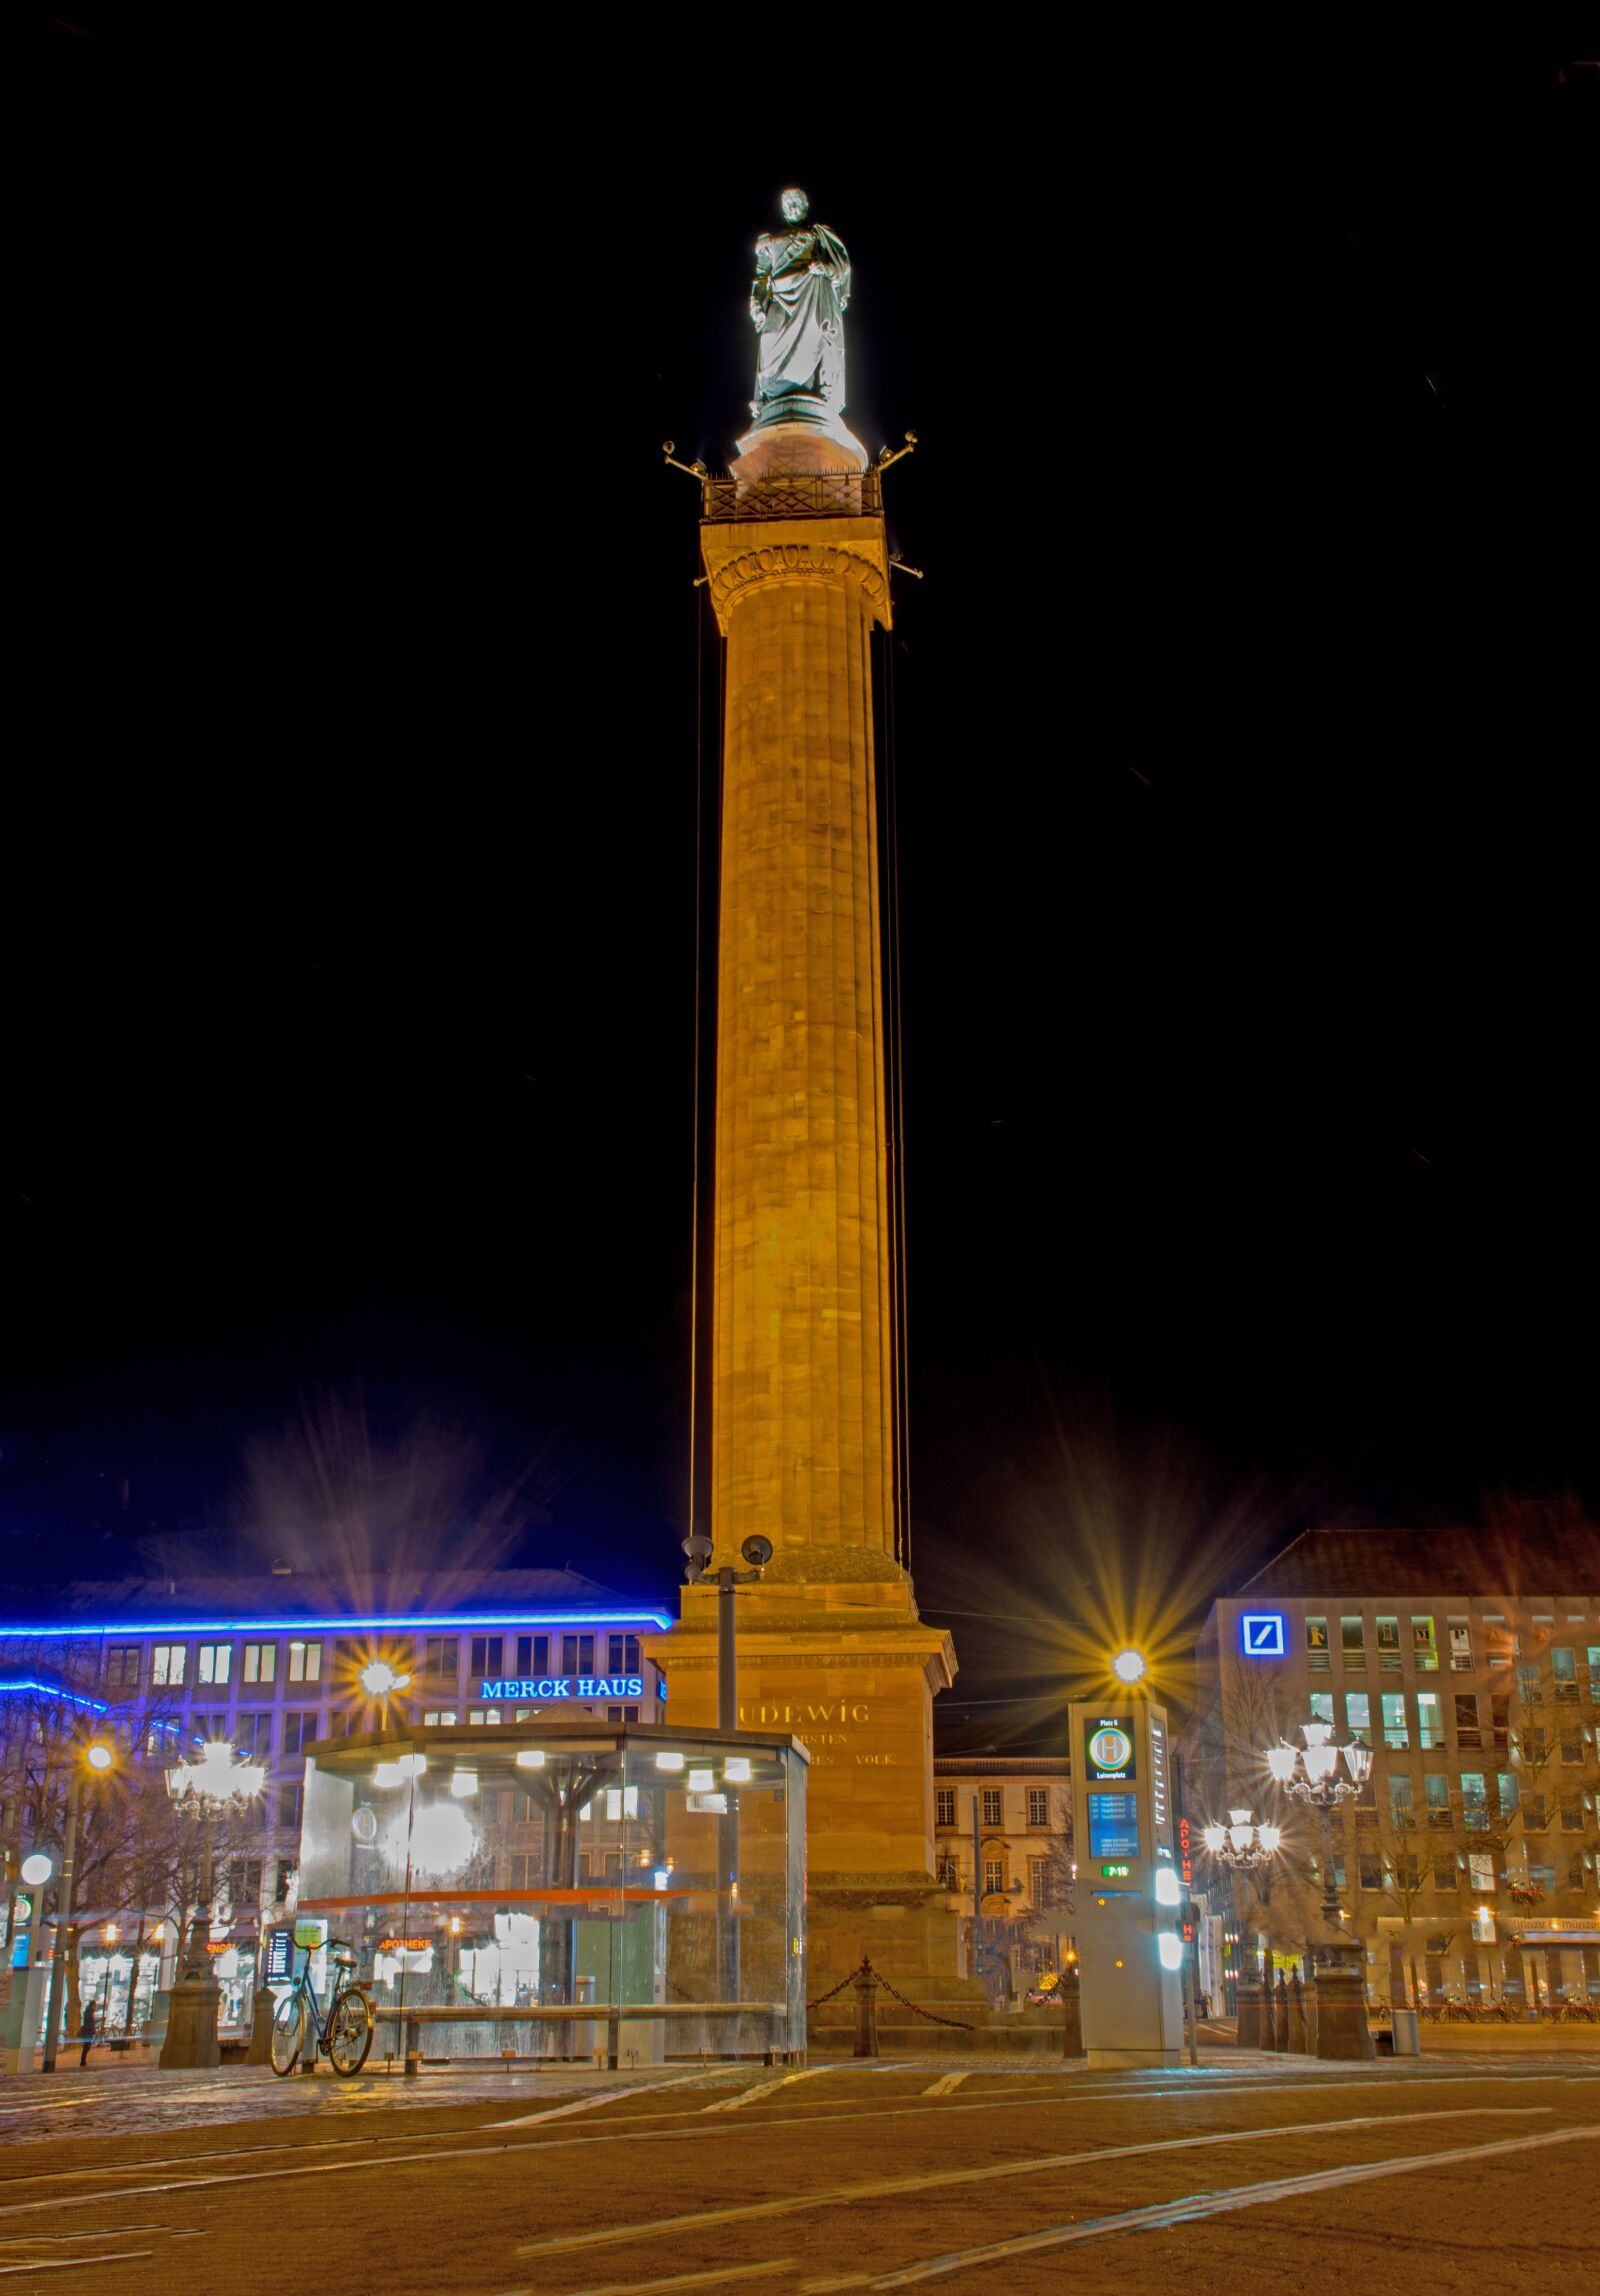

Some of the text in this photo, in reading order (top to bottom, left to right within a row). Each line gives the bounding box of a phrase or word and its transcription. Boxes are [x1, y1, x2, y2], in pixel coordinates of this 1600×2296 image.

[482, 1680, 570, 1698] MERCK
[577, 1678, 642, 1696] HAUS
[739, 1700, 869, 1723] UDEWIG
[379, 1937, 432, 1950] APOTHEKE
